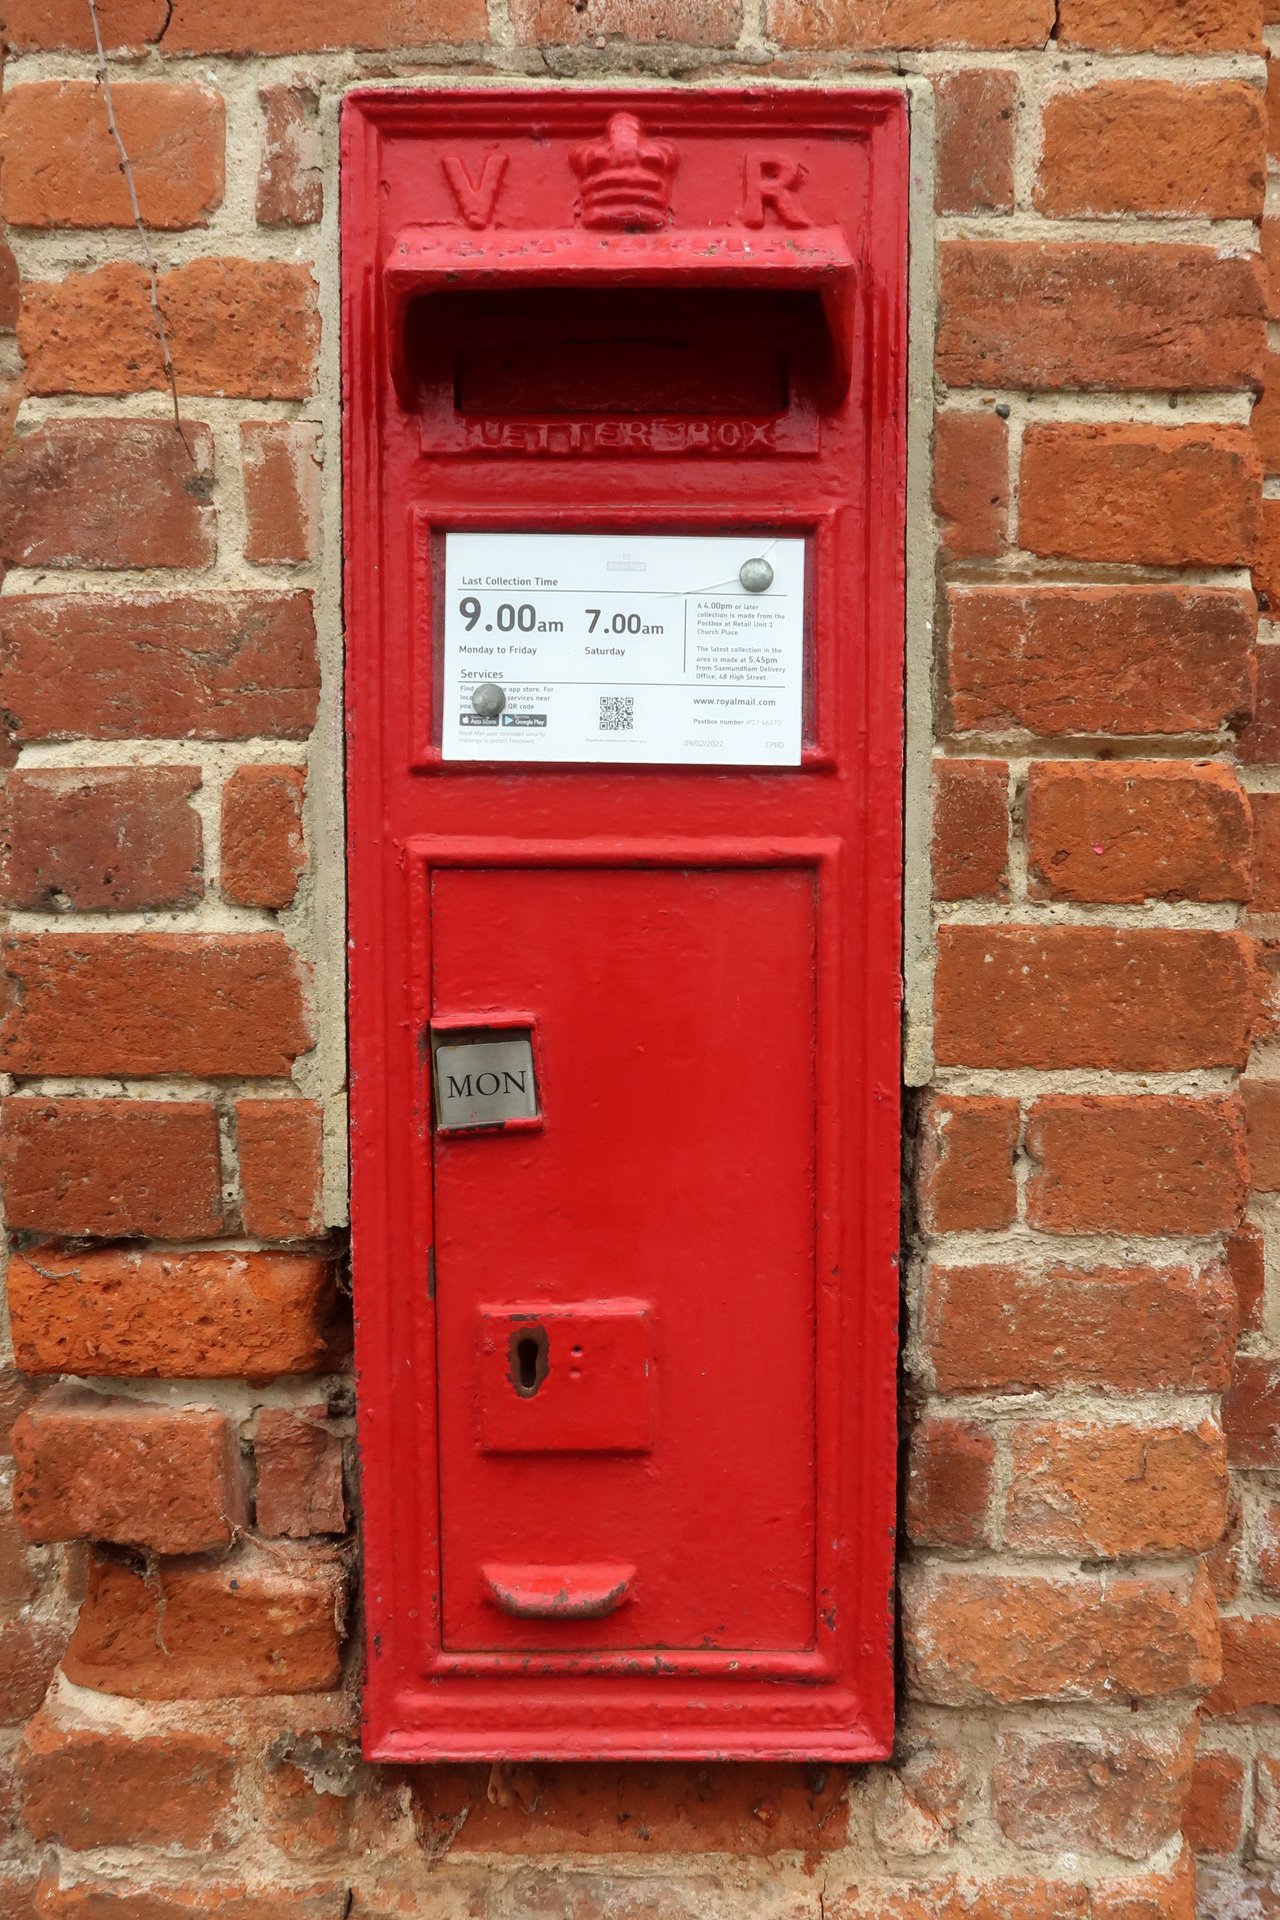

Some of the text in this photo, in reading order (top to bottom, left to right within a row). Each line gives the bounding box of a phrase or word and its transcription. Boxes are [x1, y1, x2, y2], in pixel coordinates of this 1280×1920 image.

[441, 151, 812, 231] V R
[468, 421, 776, 448] LETTER BOX
[462, 576, 558, 586] Last Collection Time
[704, 602, 732, 611] 4.00pm
[459, 596, 564, 632] 9.00am
[585, 609, 664, 634] 7.00am
[459, 645, 537, 655] Monday to Friday
[585, 647, 625, 657] Saturday
[748, 656, 777, 665] 5.45pm
[460, 669, 504, 679] Services
[693, 698, 776, 706] www.royalmail.com
[684, 740, 724, 748] 09/02/2022
[446, 1070, 526, 1098] MON
